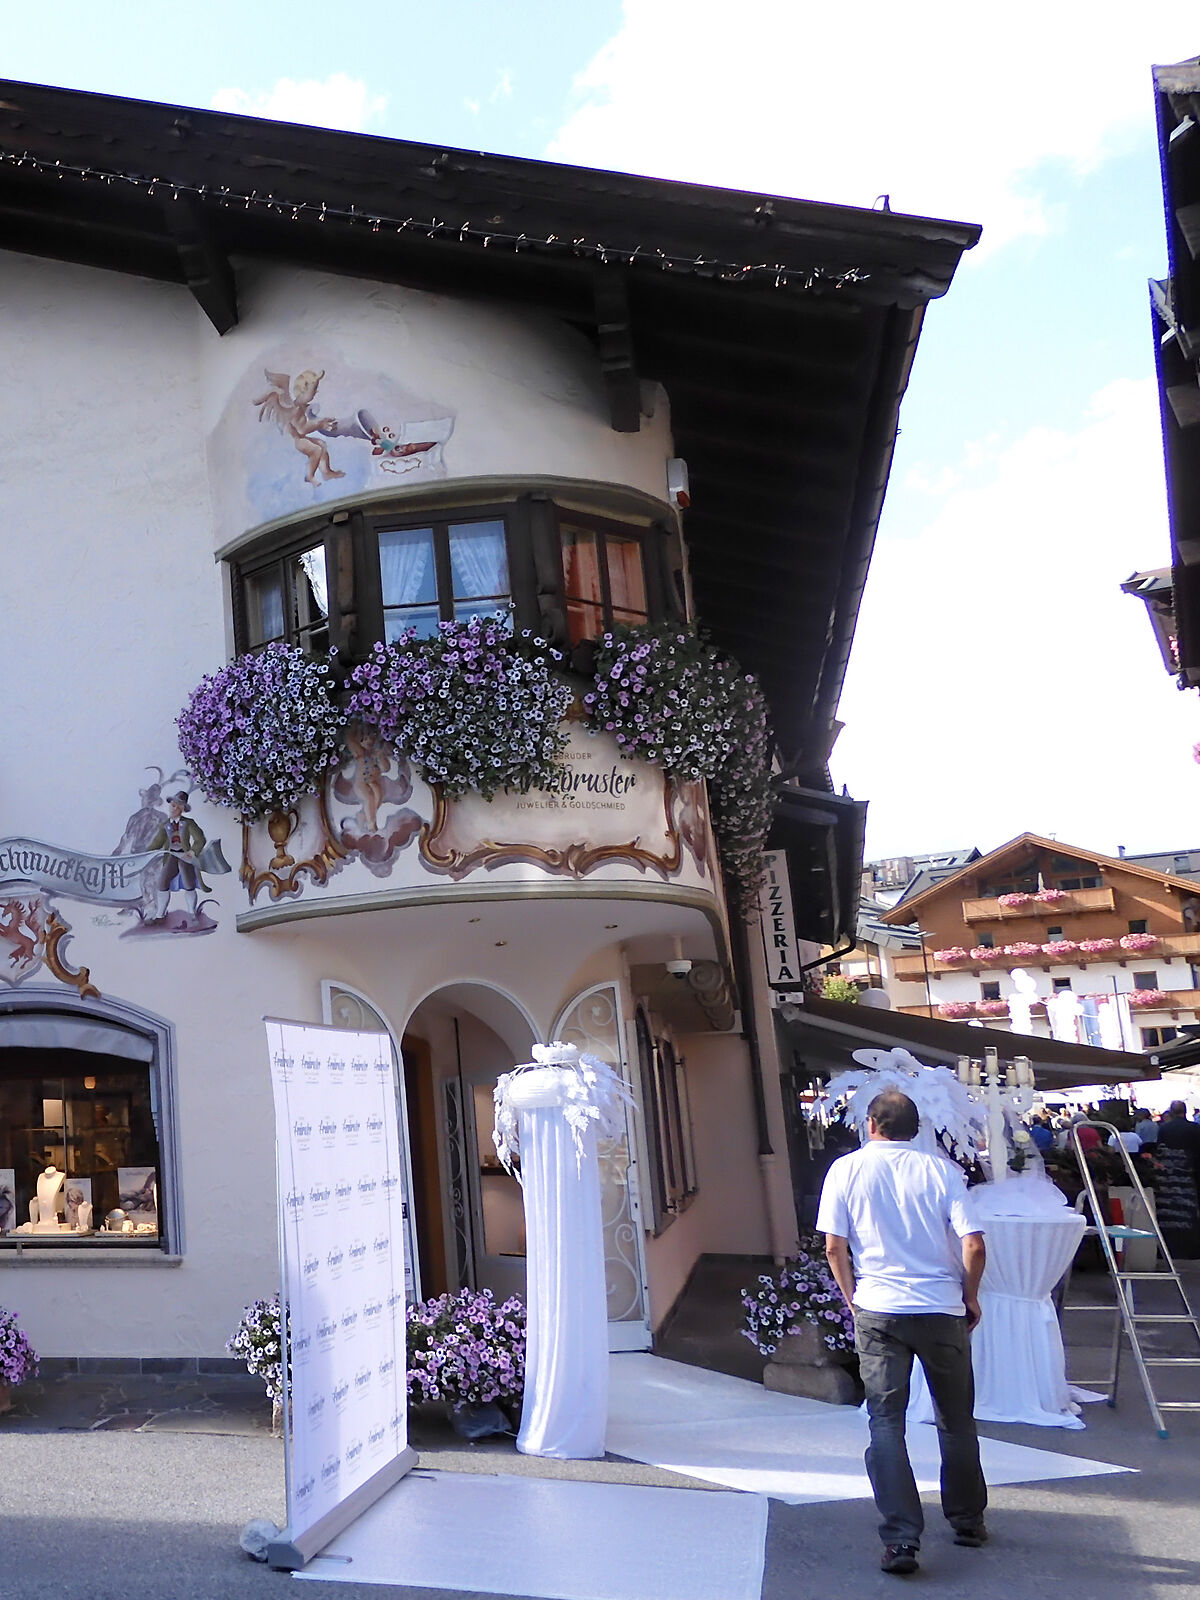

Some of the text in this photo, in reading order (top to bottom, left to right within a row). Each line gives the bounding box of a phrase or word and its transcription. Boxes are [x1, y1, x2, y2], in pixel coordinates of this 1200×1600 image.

[516, 801, 626, 811] JUWELIER & GOLDSCHMIED
[763, 854, 794, 980] PIZZERIA
